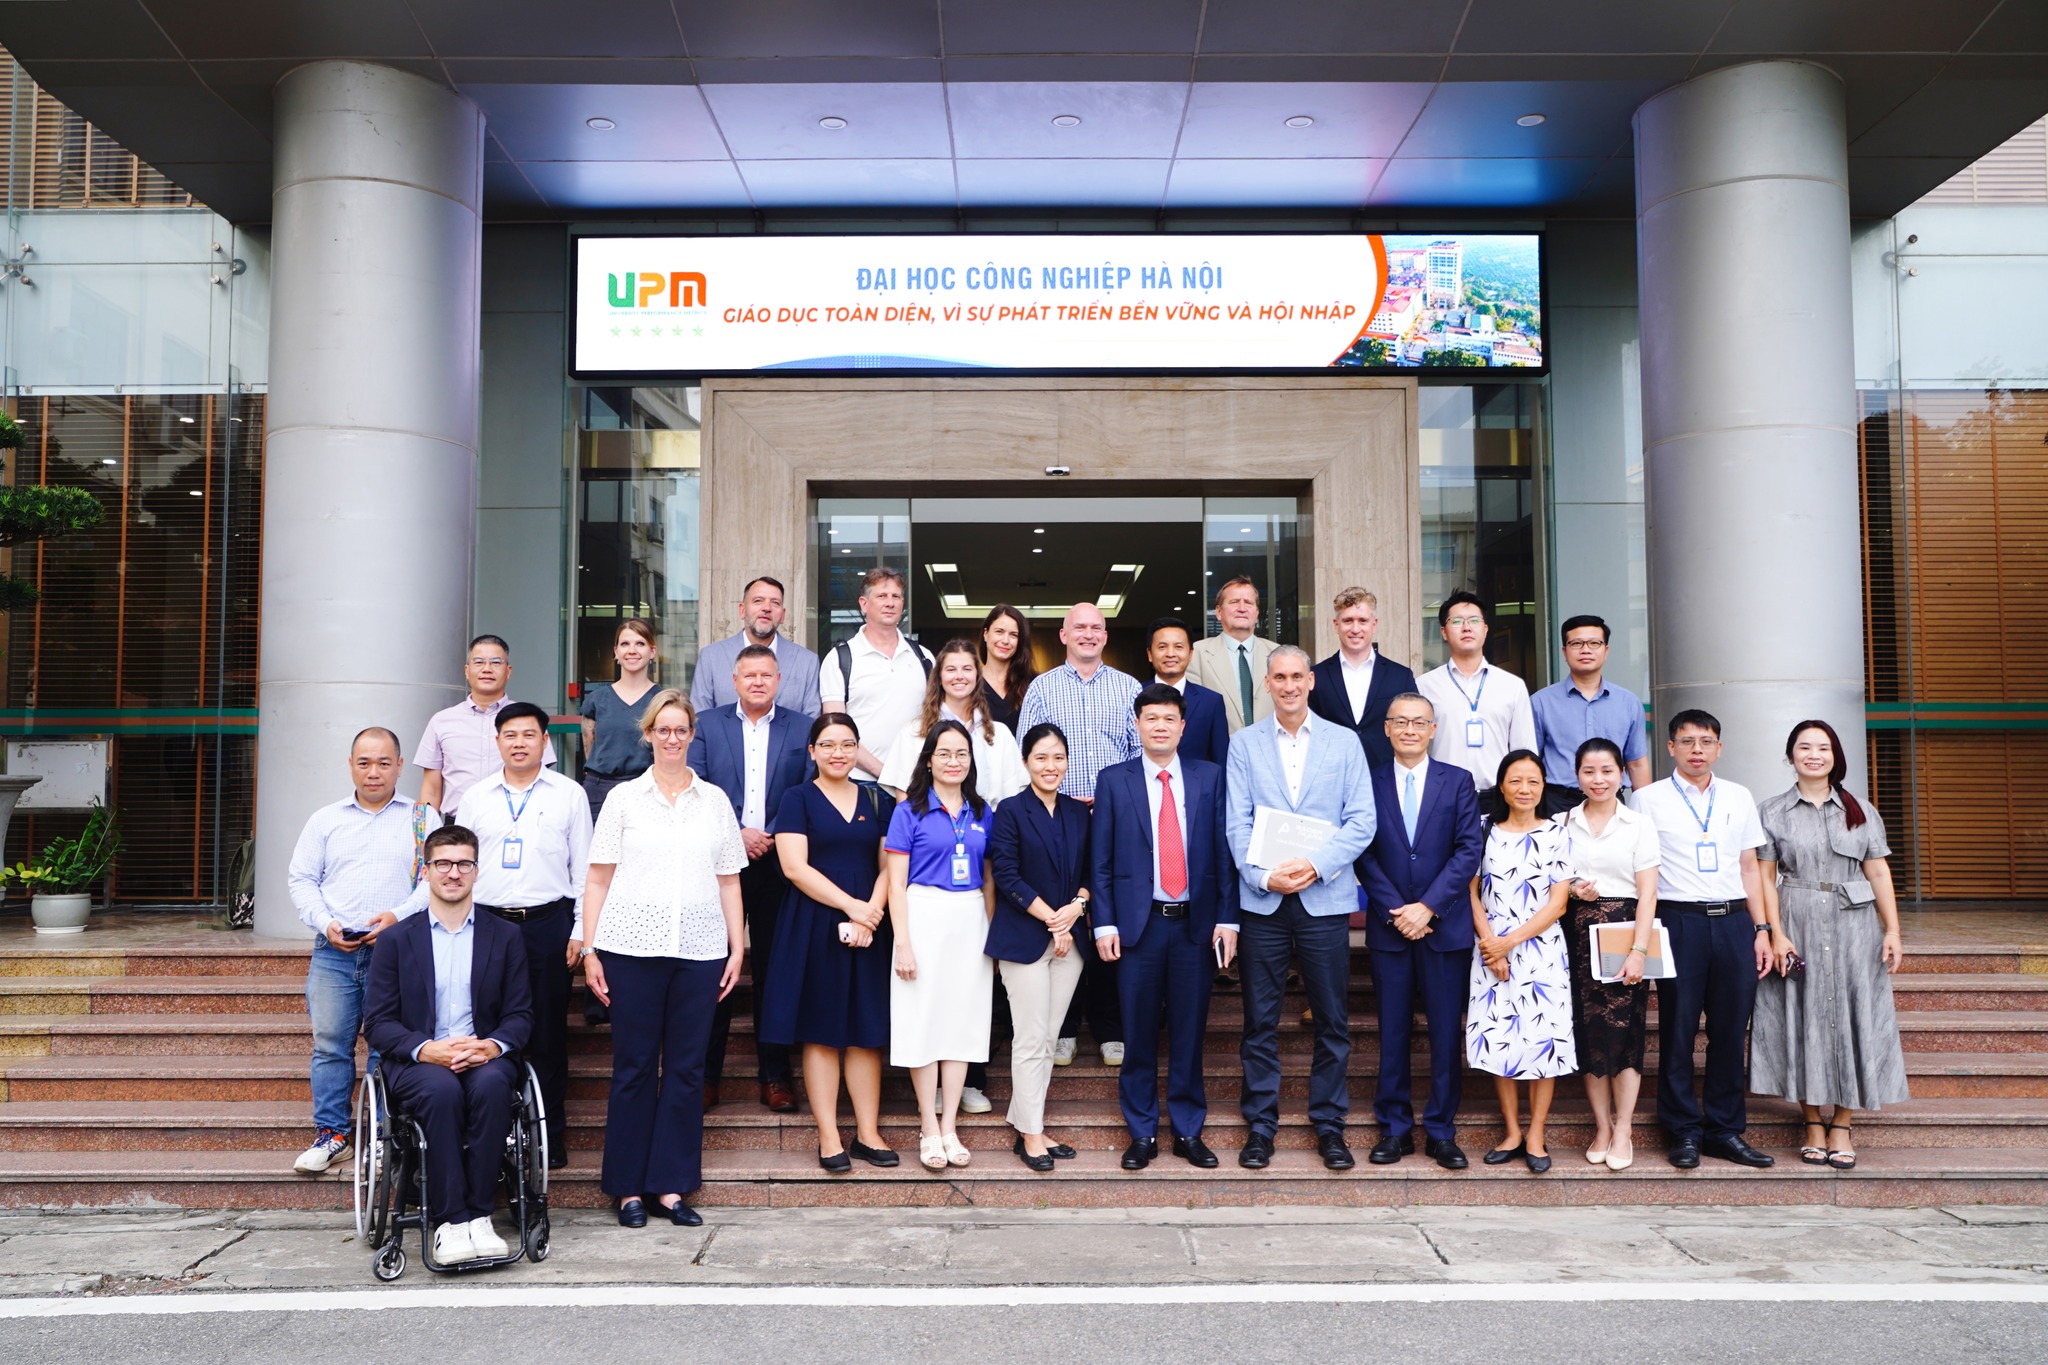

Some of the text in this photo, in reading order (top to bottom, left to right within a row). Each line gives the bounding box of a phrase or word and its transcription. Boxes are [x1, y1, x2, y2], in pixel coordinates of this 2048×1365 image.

[856, 261, 1222, 296] ĐẠI HỌC CÔNG NGHIỆP HÀ NỘI
[723, 304, 771, 323] GIÁO
[777, 307, 818, 326] DỤC
[825, 303, 879, 322] TOÀN
[884, 302, 935, 325] DIỆN,
[943, 302, 961, 321] VÌ
[967, 304, 994, 325] SỰ
[998, 302, 1051, 321] PHÁT
[1119, 300, 1159, 321] BỀN
[1165, 301, 1220, 321] VỮNG
[1227, 301, 1252, 320] VÀ
[1259, 301, 1294, 324] HỘI
[1300, 301, 1356, 323] NHẬP
